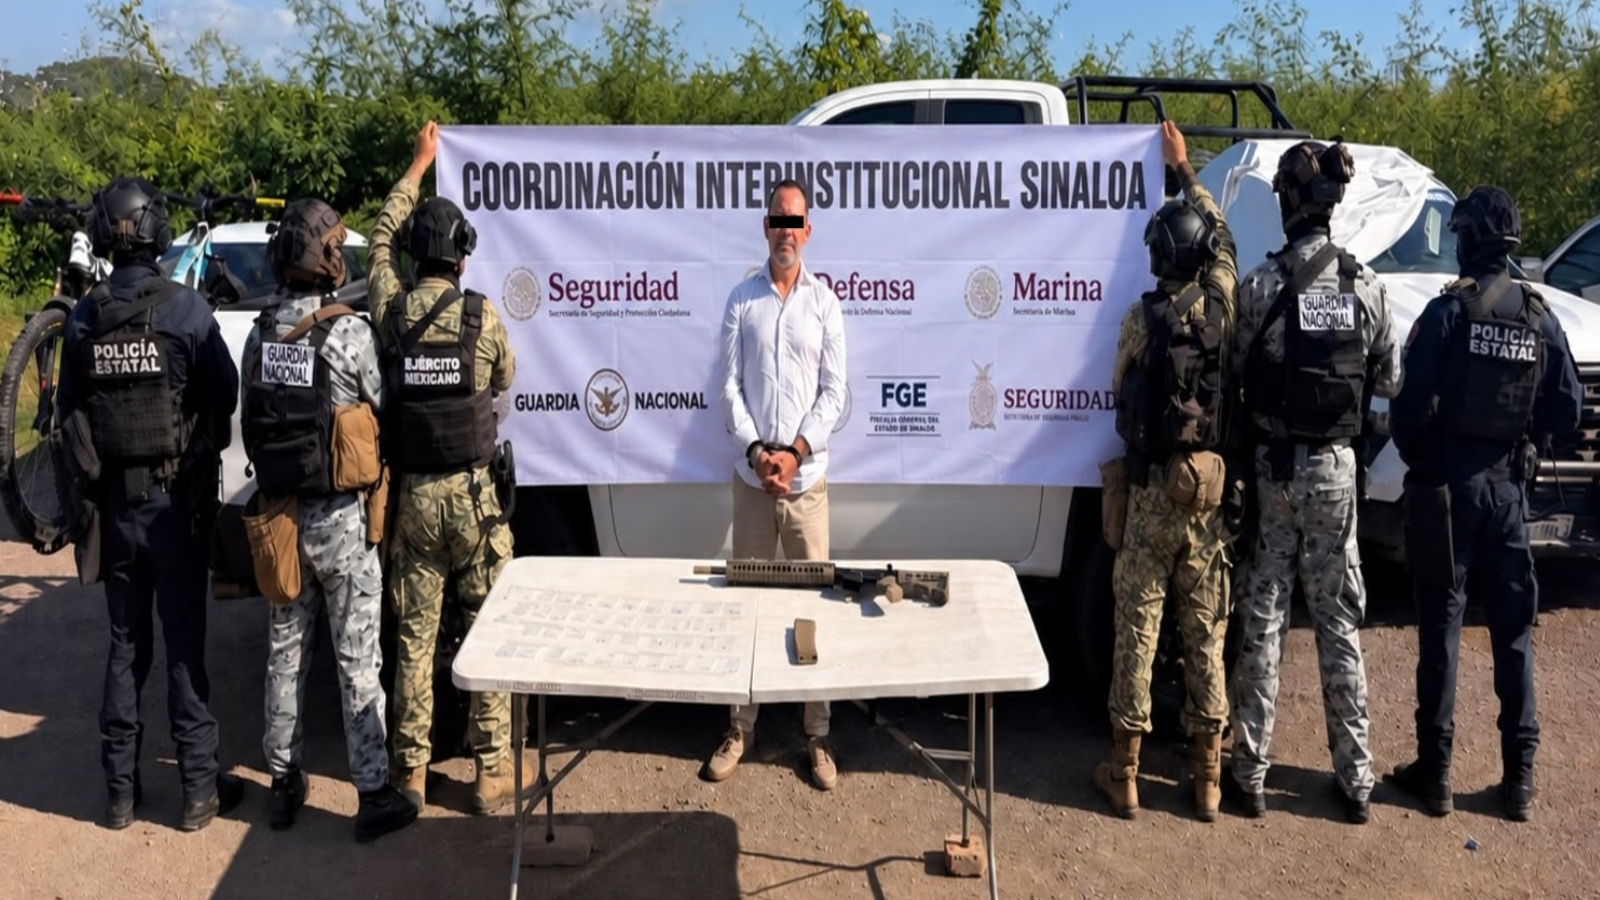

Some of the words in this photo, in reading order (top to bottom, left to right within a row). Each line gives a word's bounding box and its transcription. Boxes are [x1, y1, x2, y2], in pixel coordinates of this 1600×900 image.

[462, 151, 685, 211] COORDINACIÓN
[1020, 160, 1147, 209] SINALOA
[548, 270, 679, 309] Seguridad
[1013, 271, 1102, 301] Marina
[1304, 294, 1348, 311] GUARDIA
[1301, 311, 1353, 329] NACIONAL
[1470, 323, 1537, 346] POLICÍA
[93, 338, 159, 360] POLICÍA
[268, 344, 309, 367] GUARDIA
[1469, 338, 1537, 361] ESTATAL
[95, 356, 162, 375] ESTATAL
[263, 363, 310, 385] NACIONAL
[404, 355, 460, 371] EJÉRCITO
[404, 372, 460, 385] MEXICANO
[514, 394, 580, 411] GUARDIA
[634, 392, 708, 410] NACIONAL
[881, 382, 927, 408] FGE
[1003, 388, 1116, 411] SEGURIDAD
